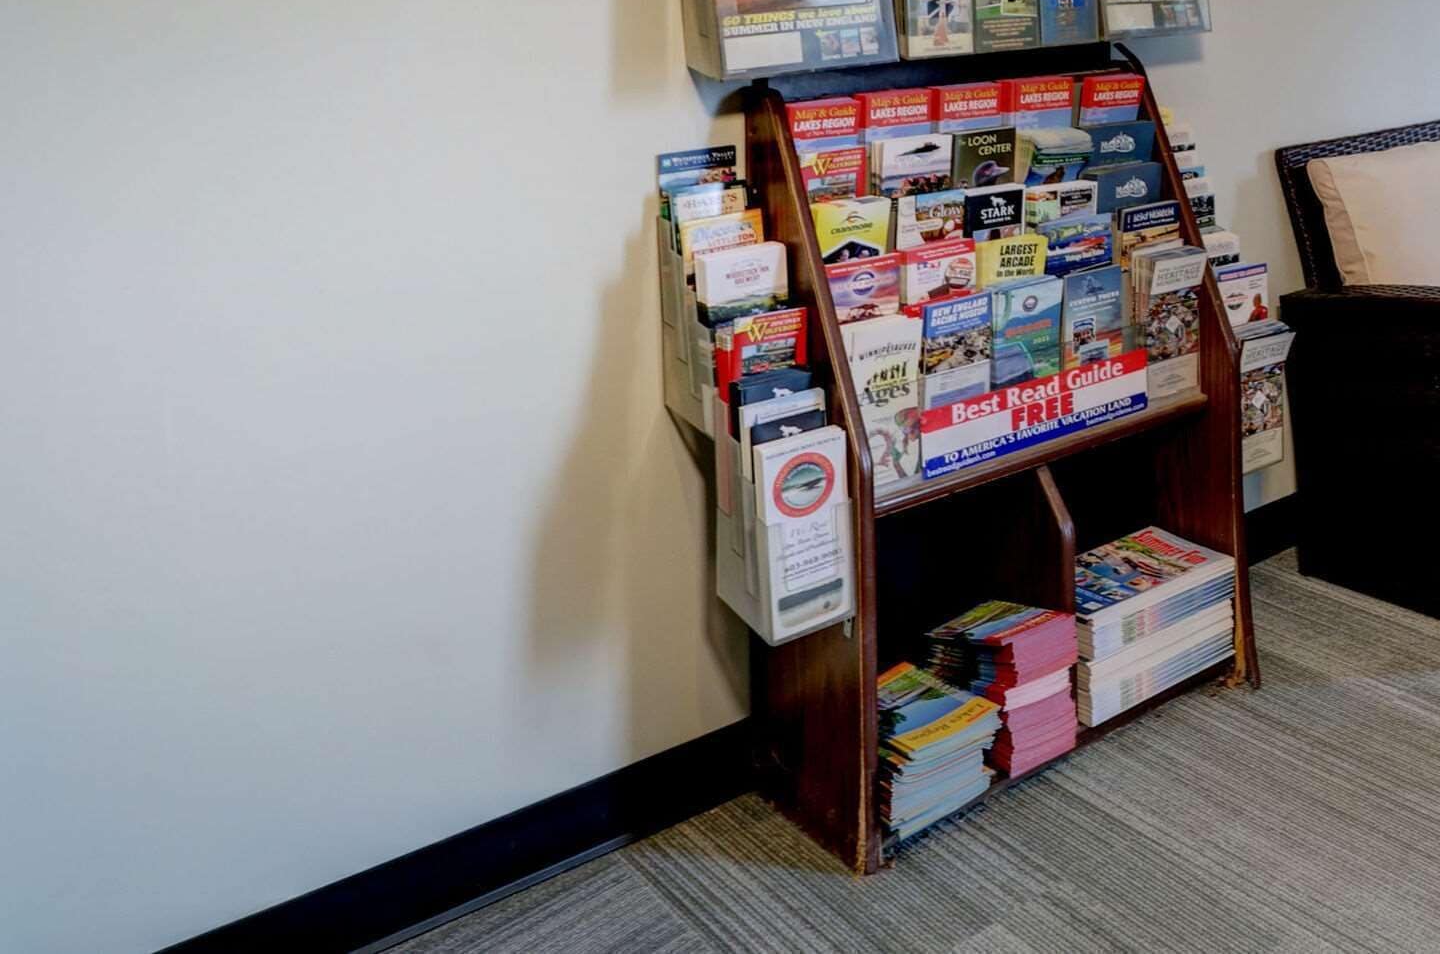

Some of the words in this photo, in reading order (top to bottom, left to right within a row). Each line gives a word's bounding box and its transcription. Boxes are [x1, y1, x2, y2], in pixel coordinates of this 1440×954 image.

[1020, 92, 1041, 104] LAKES
[1043, 90, 1069, 102] REGION
[1094, 90, 1113, 102] LAKES
[1115, 88, 1138, 100] REGION
[871, 107, 896, 119] LAKES
[897, 105, 928, 116] REGION
[944, 101, 964, 113] LAKES
[967, 98, 997, 110] REGION
[794, 119, 821, 132] LAKES
[822, 117, 855, 128] REGION
[967, 134, 997, 147] LOON
[978, 143, 1012, 156] CENTER
[980, 204, 1015, 220] STARK
[1000, 244, 1038, 255] LARGEST
[1000, 255, 1035, 267] ARCADE
[952, 297, 988, 311] ENGLAND
[931, 312, 958, 327] RACING
[857, 383, 910, 407] Ages
[952, 398, 999, 425] Best
[1006, 378, 1060, 408] Read
[1067, 361, 1123, 389] Guide
[1011, 392, 1073, 432] FREE
[943, 452, 959, 464] TO
[960, 434, 1016, 458] AMERICA'S
[1016, 421, 1060, 441] FAVORITE
[1061, 405, 1106, 425] VACATION
[1107, 397, 1133, 412] LAND
